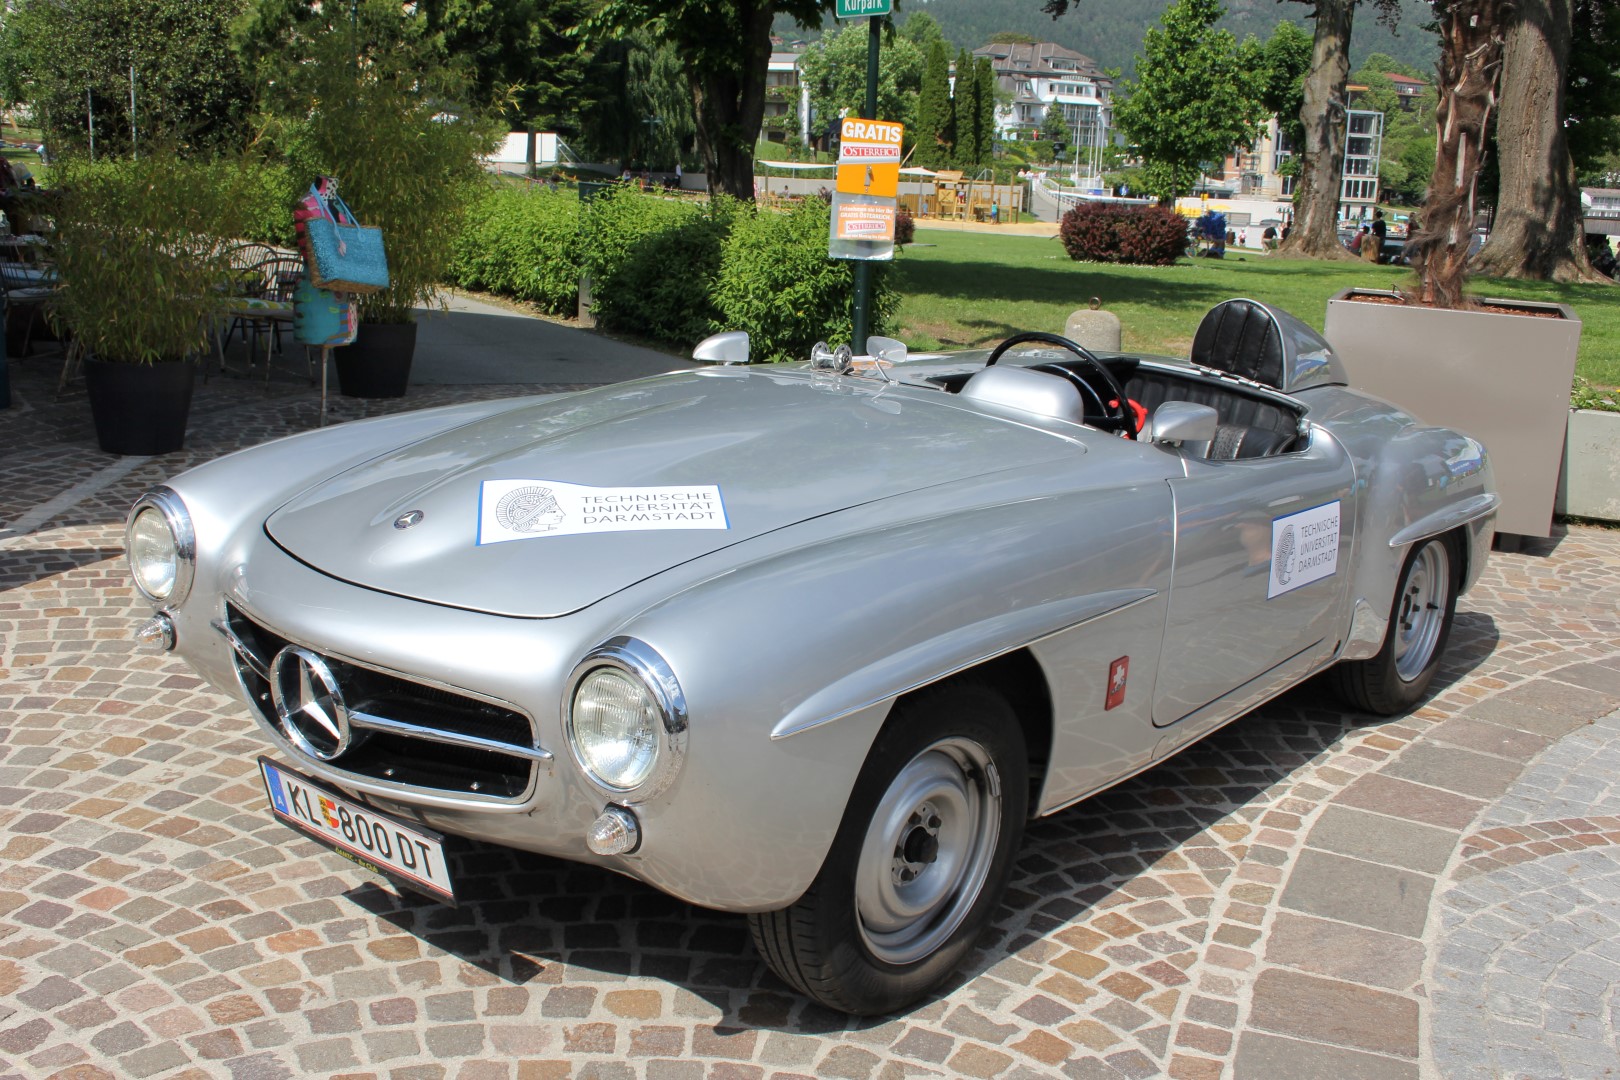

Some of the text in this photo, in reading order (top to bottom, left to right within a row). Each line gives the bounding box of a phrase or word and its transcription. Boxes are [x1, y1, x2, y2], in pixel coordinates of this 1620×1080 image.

[844, 0, 883, 13] Kurpark
[842, 121, 901, 142] GRATIS
[843, 146, 898, 156] ÖSTERREICH
[581, 492, 712, 504] TECHNISCHE
[583, 501, 714, 513] UNIVERSITÄT
[583, 511, 716, 524] DARMSTADT
[1301, 515, 1338, 538] TECHNISCHE
[1298, 548, 1336, 573] DARMSTADT
[287, 780, 433, 879] KL 800 DT
